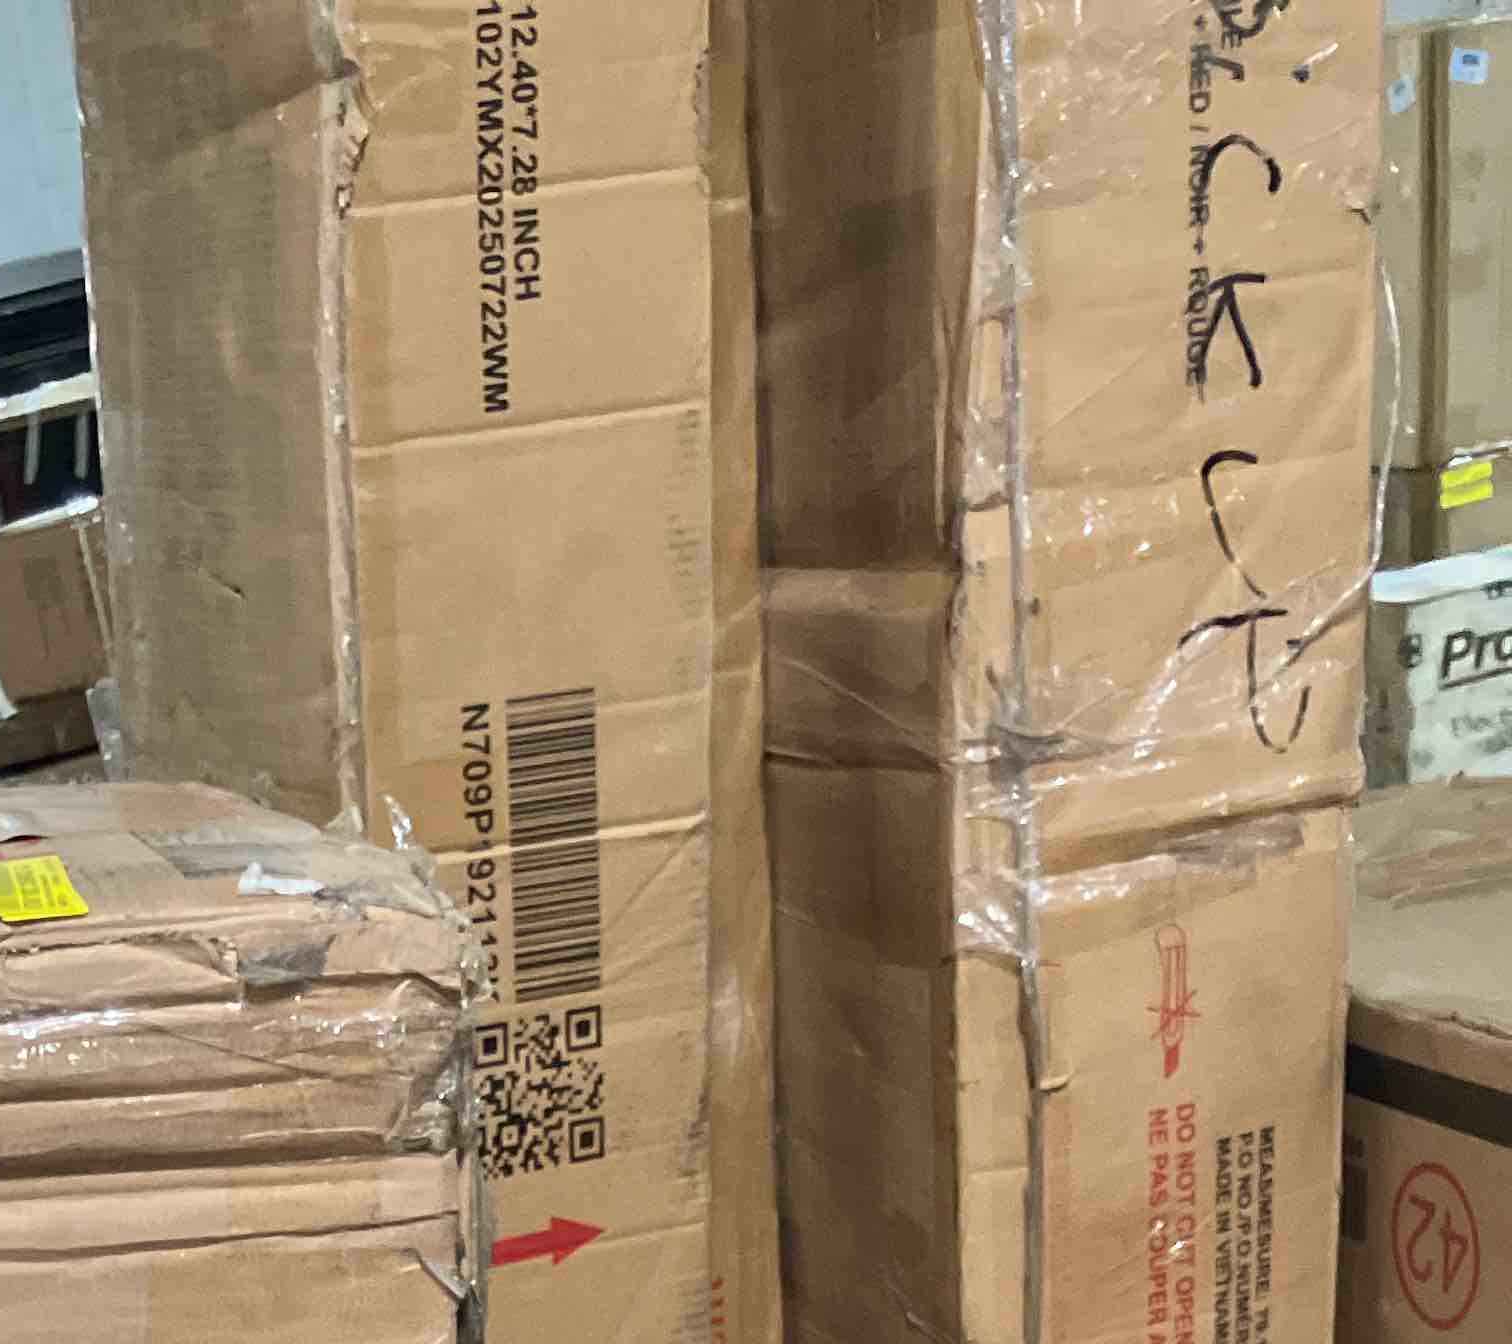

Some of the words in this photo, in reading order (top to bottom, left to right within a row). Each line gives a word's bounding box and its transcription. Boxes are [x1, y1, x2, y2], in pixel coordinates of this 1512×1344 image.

[512, 206, 540, 303] INCH
[1148, 1108, 1169, 1145] NE
[1175, 1103, 1196, 1144] DO
[1147, 1153, 1169, 1208] PAS
[1175, 1151, 1196, 1206] NOT
[1215, 1137, 1233, 1205] MADE
[1215, 1210, 1233, 1236] IN
[1146, 1215, 1169, 1327] COUPER
